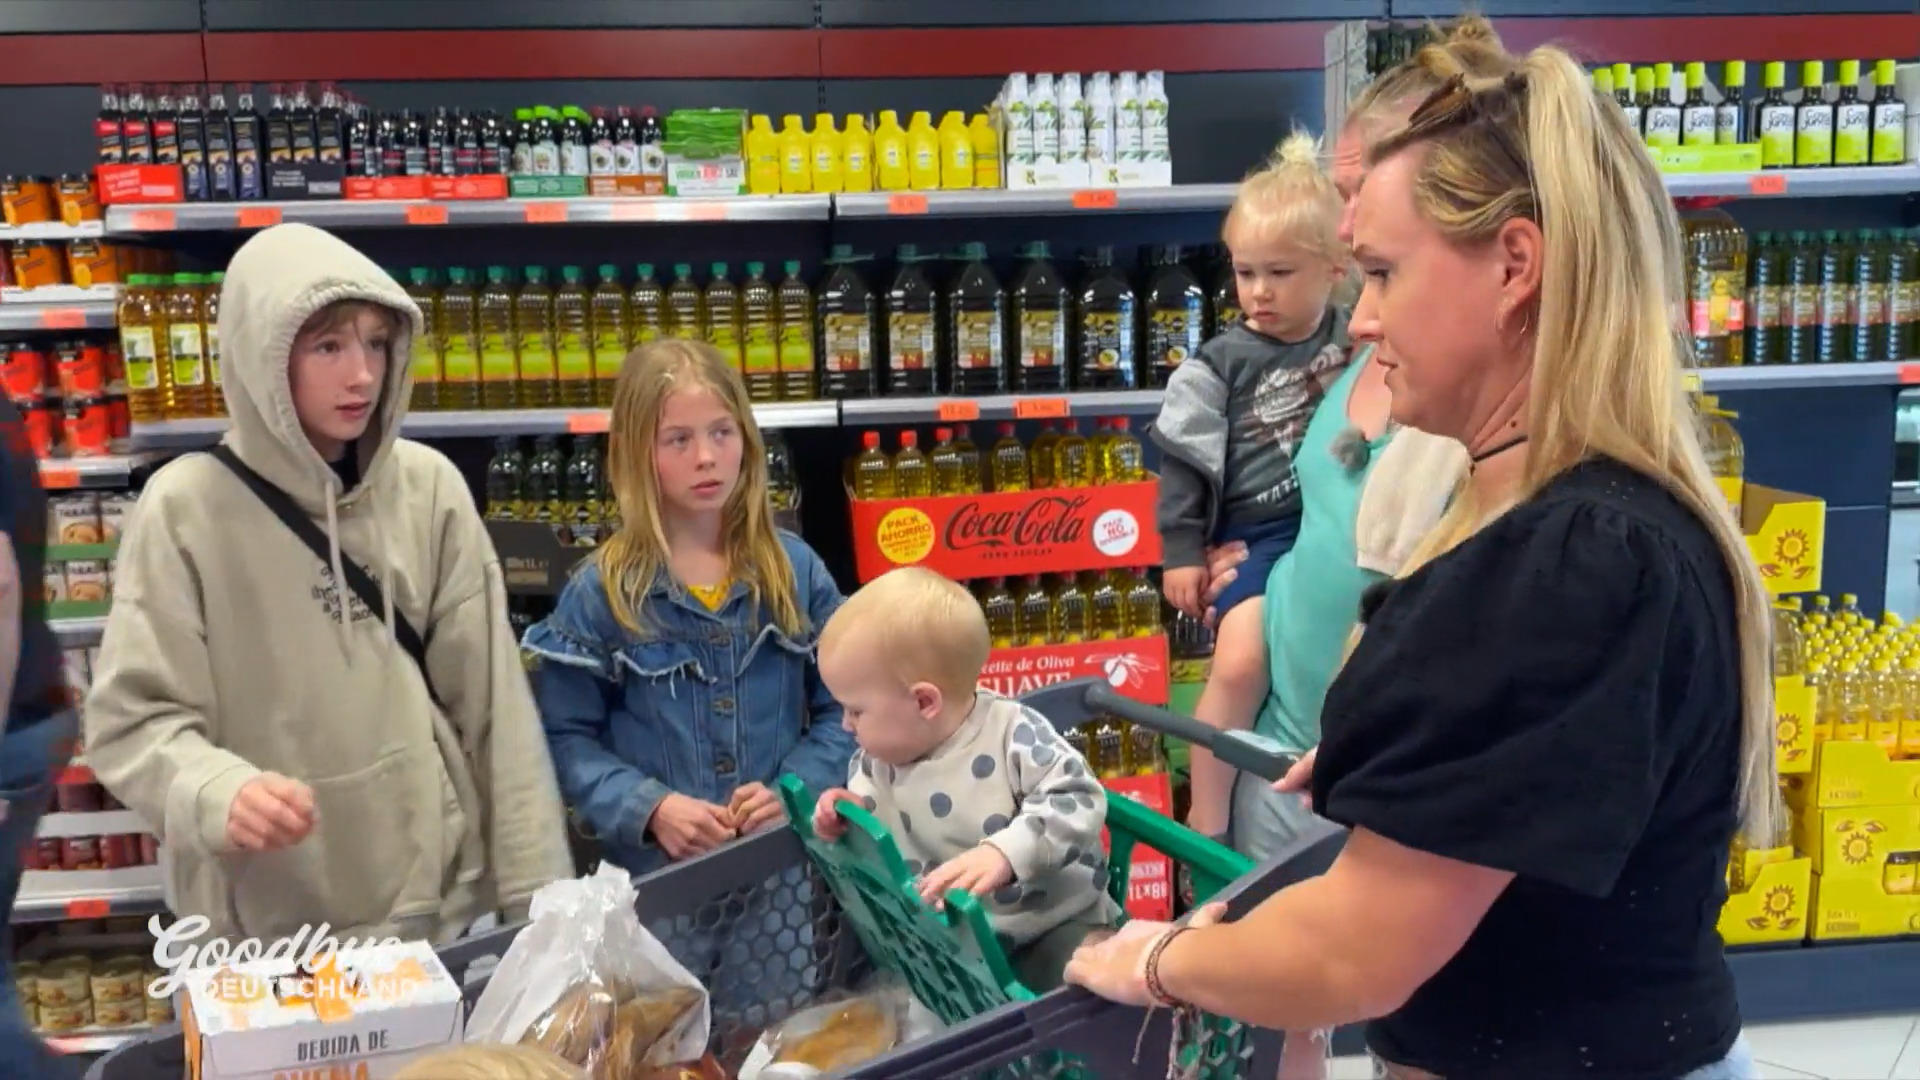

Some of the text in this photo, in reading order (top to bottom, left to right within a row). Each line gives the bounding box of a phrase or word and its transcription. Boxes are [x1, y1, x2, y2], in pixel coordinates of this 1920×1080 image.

[881, 523, 931, 543] AHORRO
[944, 496, 1091, 550] Coca-Cola
[980, 655, 1075, 674] ceite de Oliva
[297, 1028, 390, 1062] BEBIDA DE
